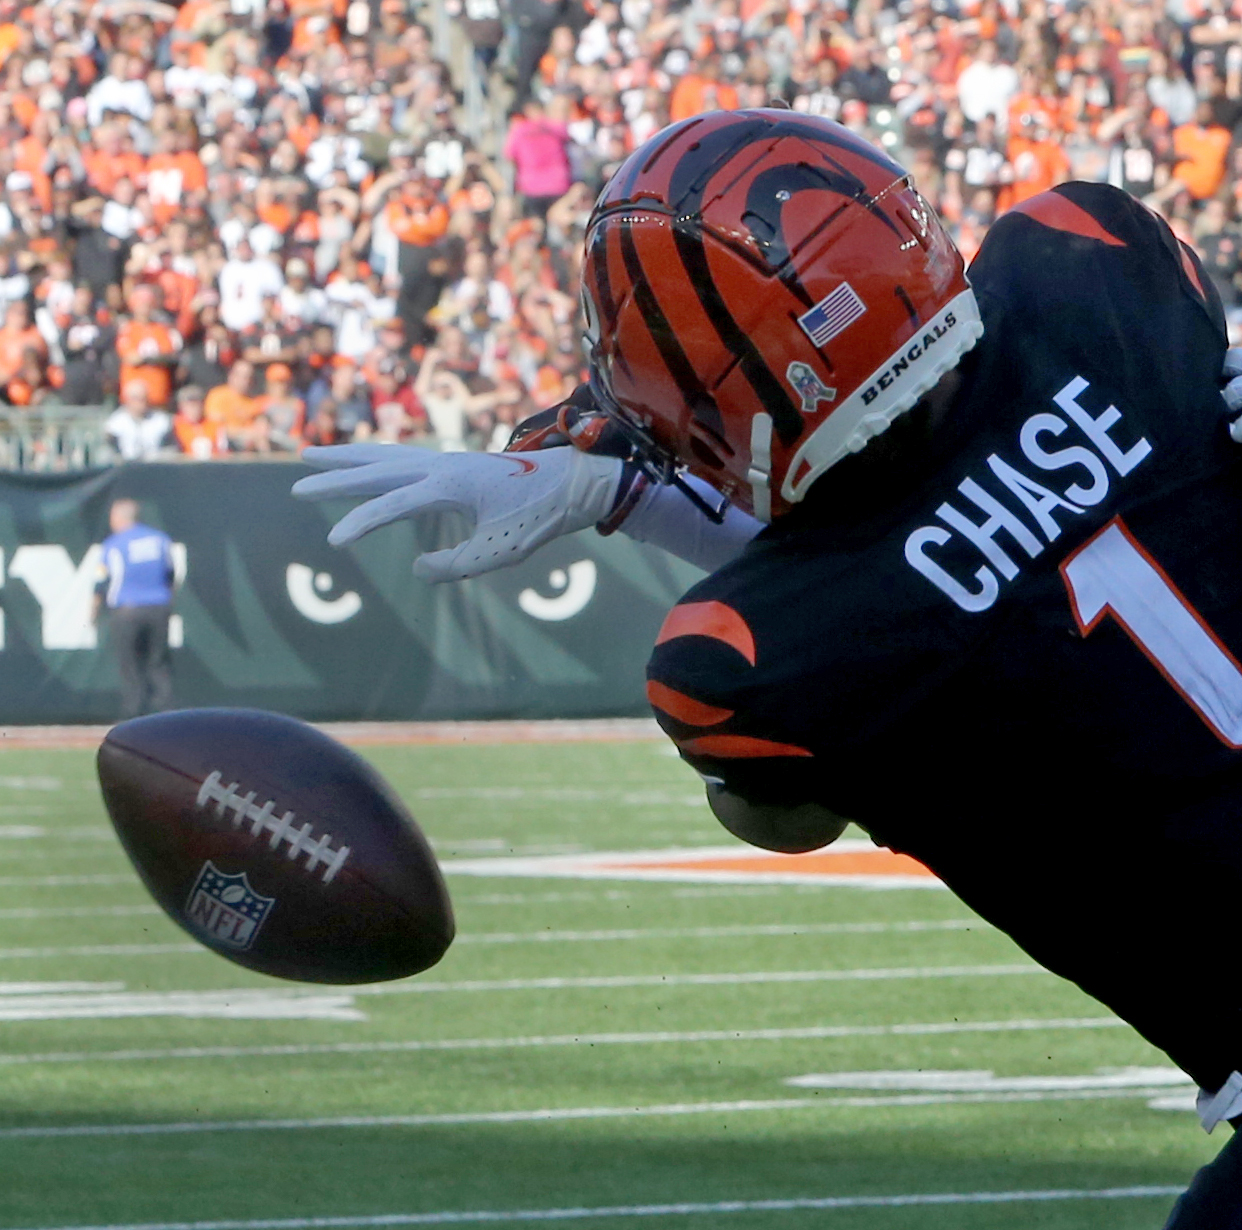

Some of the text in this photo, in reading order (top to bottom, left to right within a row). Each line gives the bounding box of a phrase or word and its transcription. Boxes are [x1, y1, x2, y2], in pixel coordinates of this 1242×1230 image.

[861, 311, 957, 406] BENGALS
[904, 376, 1153, 613] CHASE
[192, 894, 249, 942] NFL
